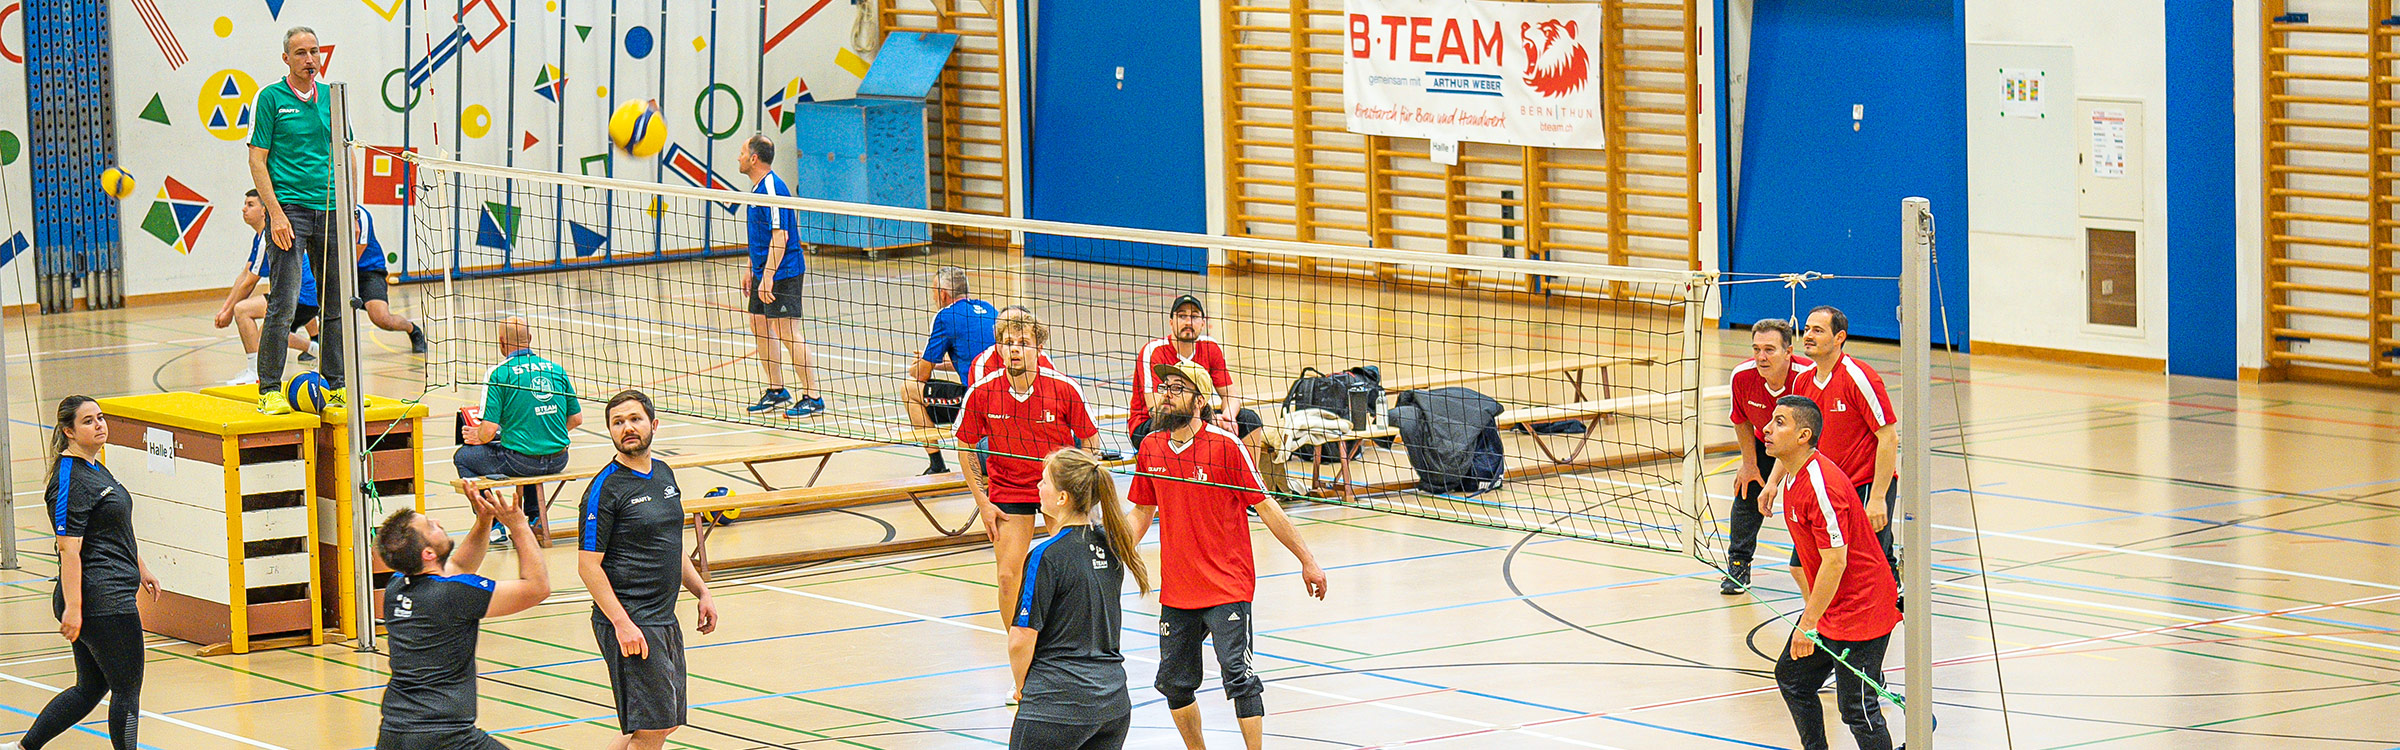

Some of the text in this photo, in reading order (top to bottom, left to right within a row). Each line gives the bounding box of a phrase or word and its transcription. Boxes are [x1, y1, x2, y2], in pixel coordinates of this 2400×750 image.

[1368, 75, 1421, 86] gemeinsam mit
[1433, 77, 1501, 91] ARTHUR WEBER
[1399, 104, 1414, 125] für
[1415, 107, 1434, 124] Bau
[1437, 107, 1458, 126] und
[1458, 109, 1506, 129] Handwerk
[1540, 121, 1574, 133] bteam.ch
[1432, 141, 1449, 153] Halle
[512, 362, 554, 375] STAFF
[149, 442, 168, 458] Halle
[169, 447, 173, 459] 2
